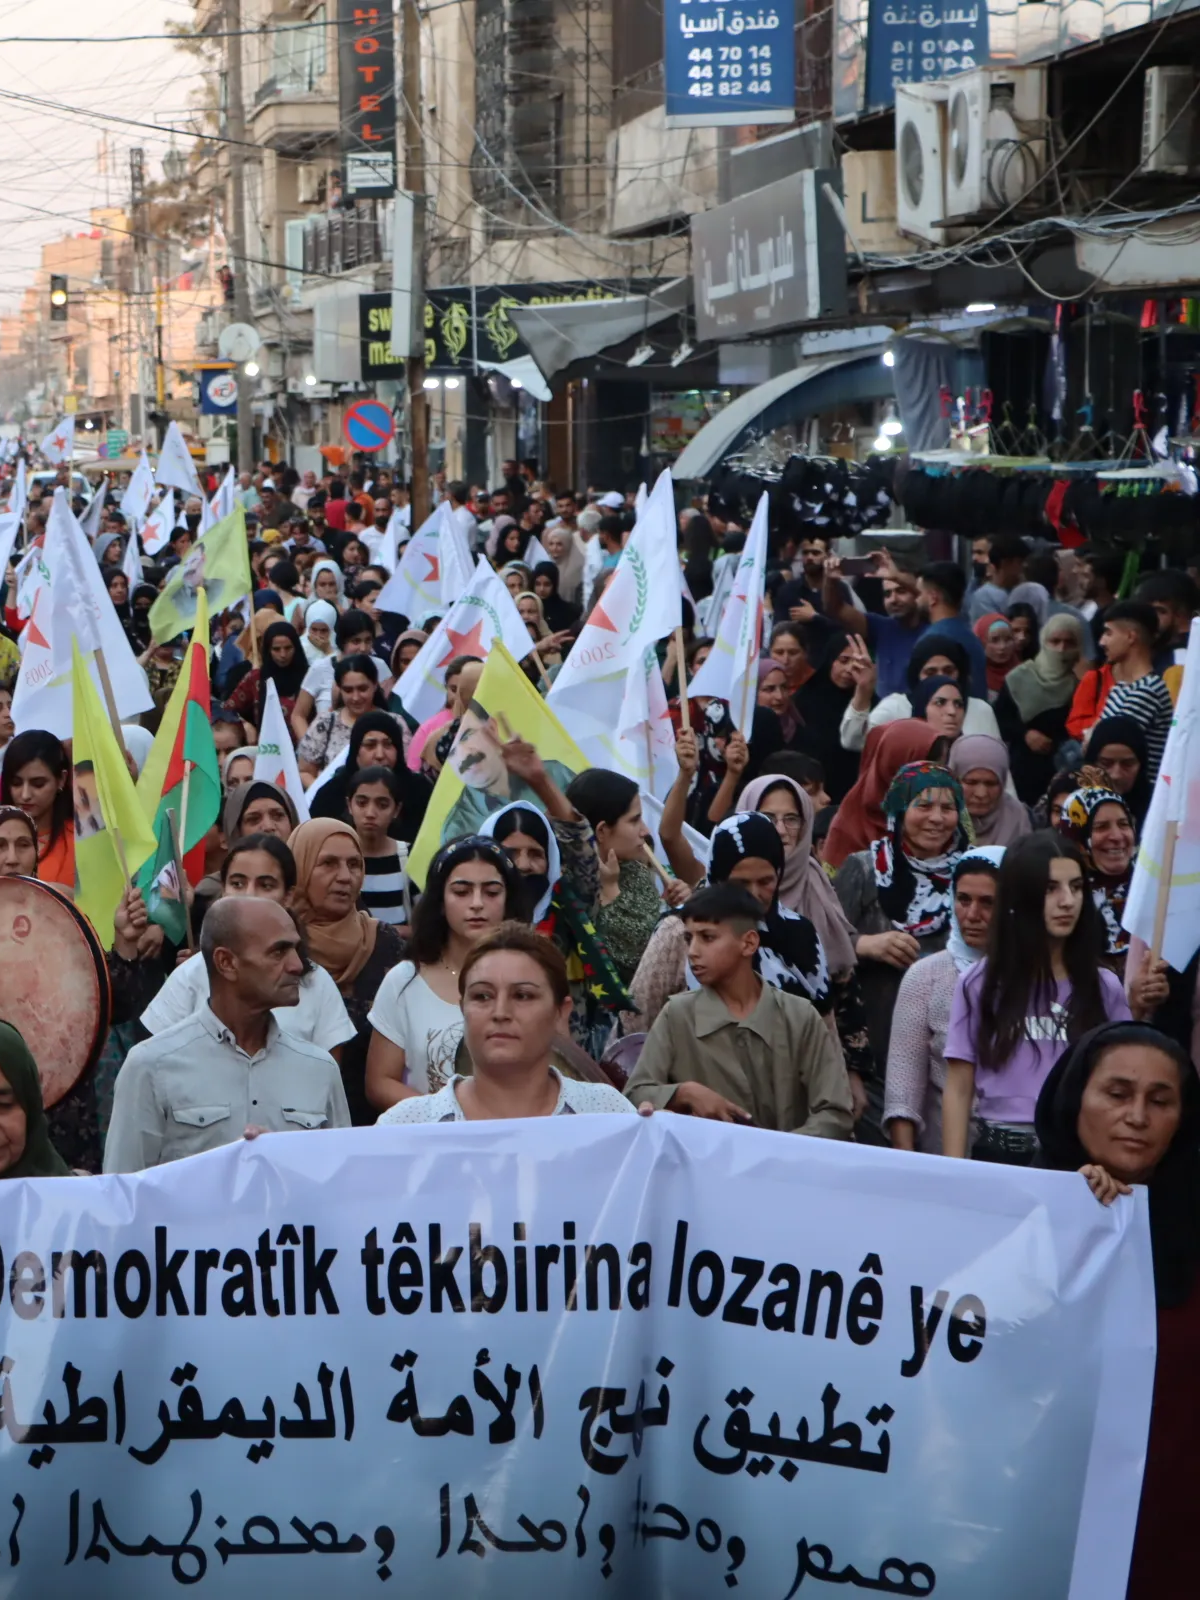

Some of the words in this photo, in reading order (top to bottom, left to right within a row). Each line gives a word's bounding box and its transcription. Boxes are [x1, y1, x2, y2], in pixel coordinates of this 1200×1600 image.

[680, 8, 725, 38] آسيا
[688, 47, 713, 62] 44
[718, 46, 742, 61] 70
[748, 44, 772, 59] 14
[726, 9, 780, 35] فندق
[353, 8, 383, 141] HOTEL
[688, 64, 713, 80] 44
[718, 64, 742, 78] 70
[748, 62, 772, 77] 15
[688, 82, 714, 97] 42
[718, 81, 743, 96] 82
[747, 79, 772, 94] 44
[361, 1221, 653, 1316] têkbirina
[667, 1219, 884, 1346] lozanê
[900, 1285, 987, 1379] ye
[386, 1347, 545, 1445] الأمة
[578, 1356, 675, 1475] نهج
[693, 1383, 895, 1483] تطبيق
